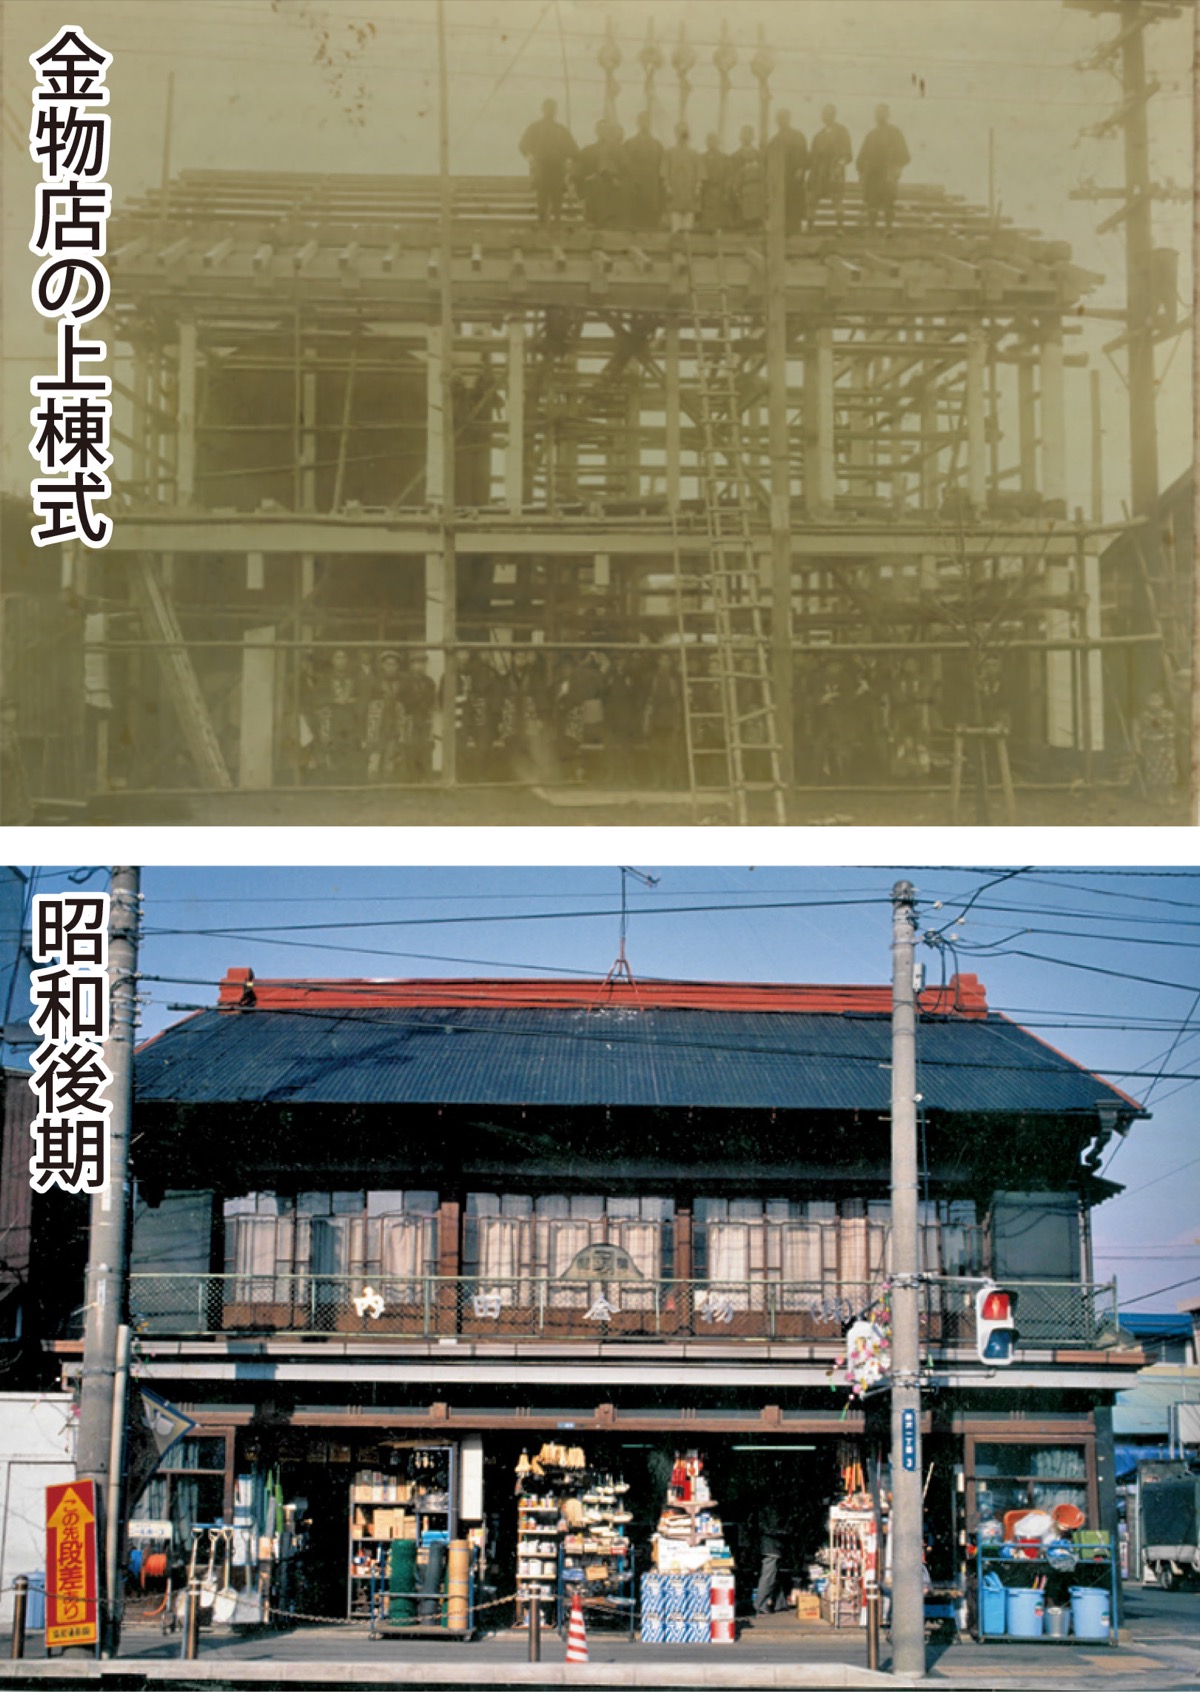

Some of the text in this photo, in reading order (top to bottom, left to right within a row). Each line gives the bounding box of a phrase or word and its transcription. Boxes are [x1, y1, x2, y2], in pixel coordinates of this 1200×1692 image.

[58, 1499, 84, 1620] この先段差あり
